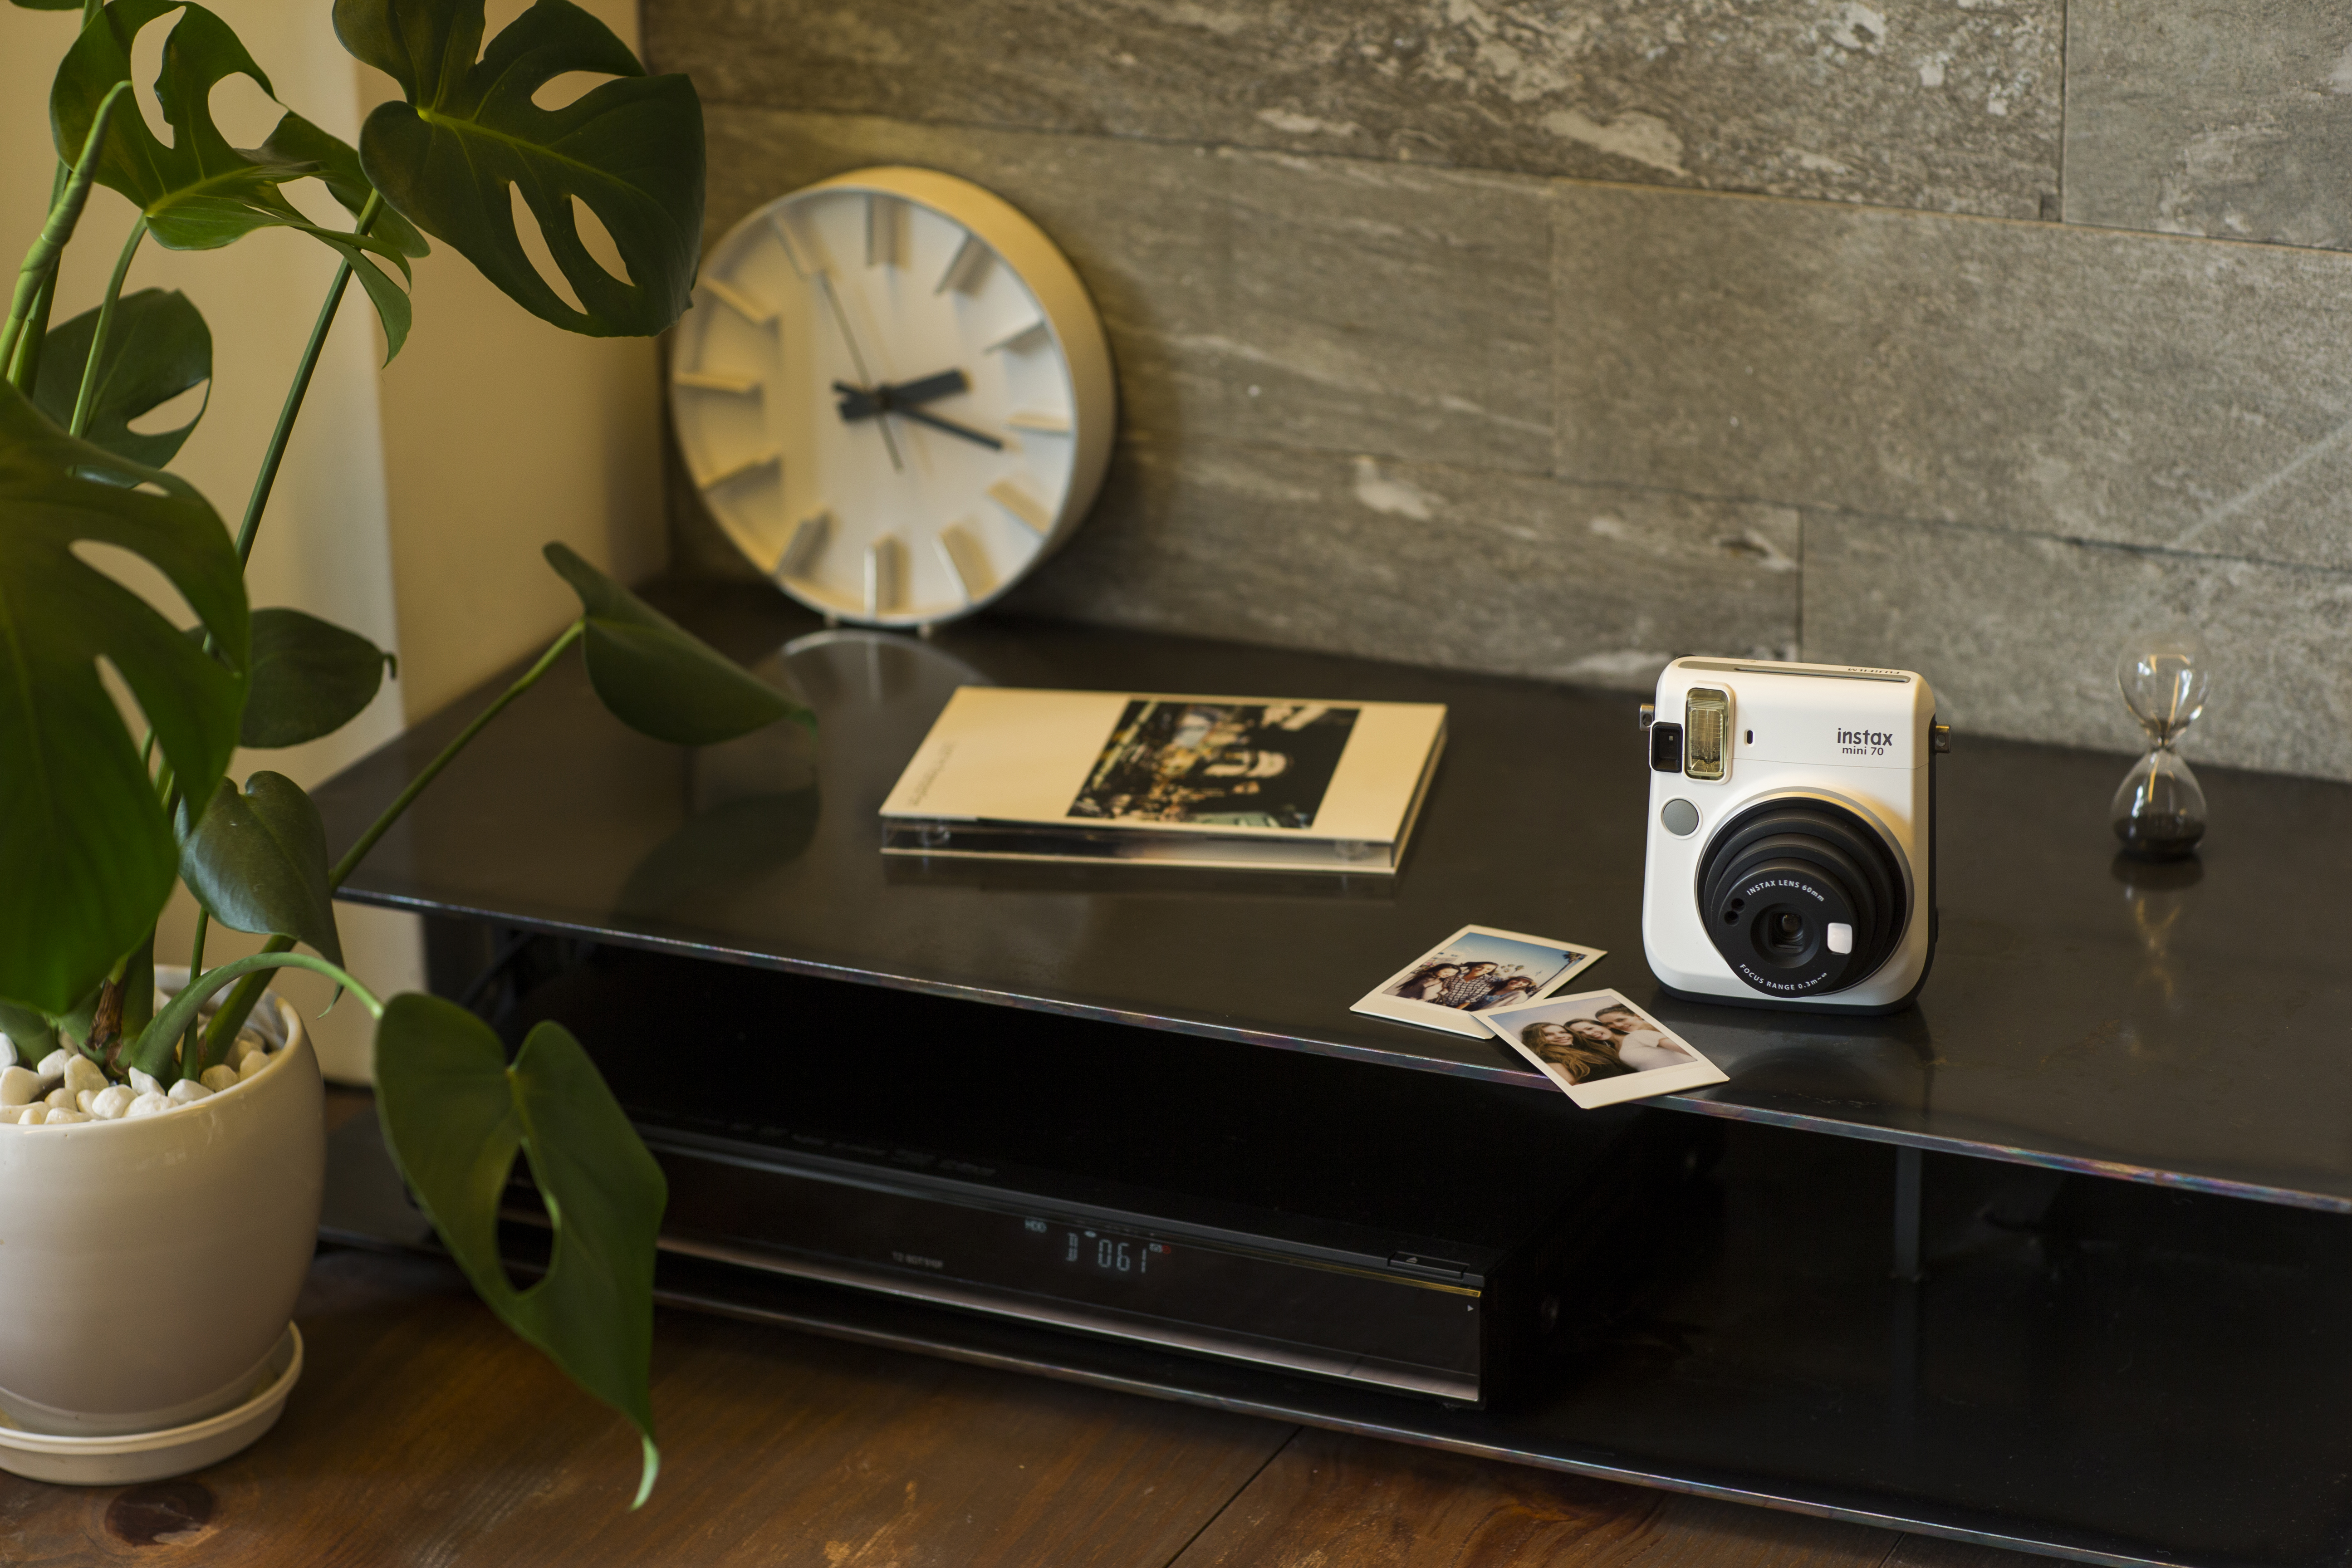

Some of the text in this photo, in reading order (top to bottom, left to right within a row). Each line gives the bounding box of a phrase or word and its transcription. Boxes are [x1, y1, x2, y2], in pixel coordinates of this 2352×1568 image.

[1837, 727, 1893, 746] instax
[1842, 745, 1884, 756] mini 70
[1746, 879, 1825, 902] INSTAX LENS 60mm
[1739, 964, 1764, 984] FOCUS
[1766, 981, 1796, 990] RANGE
